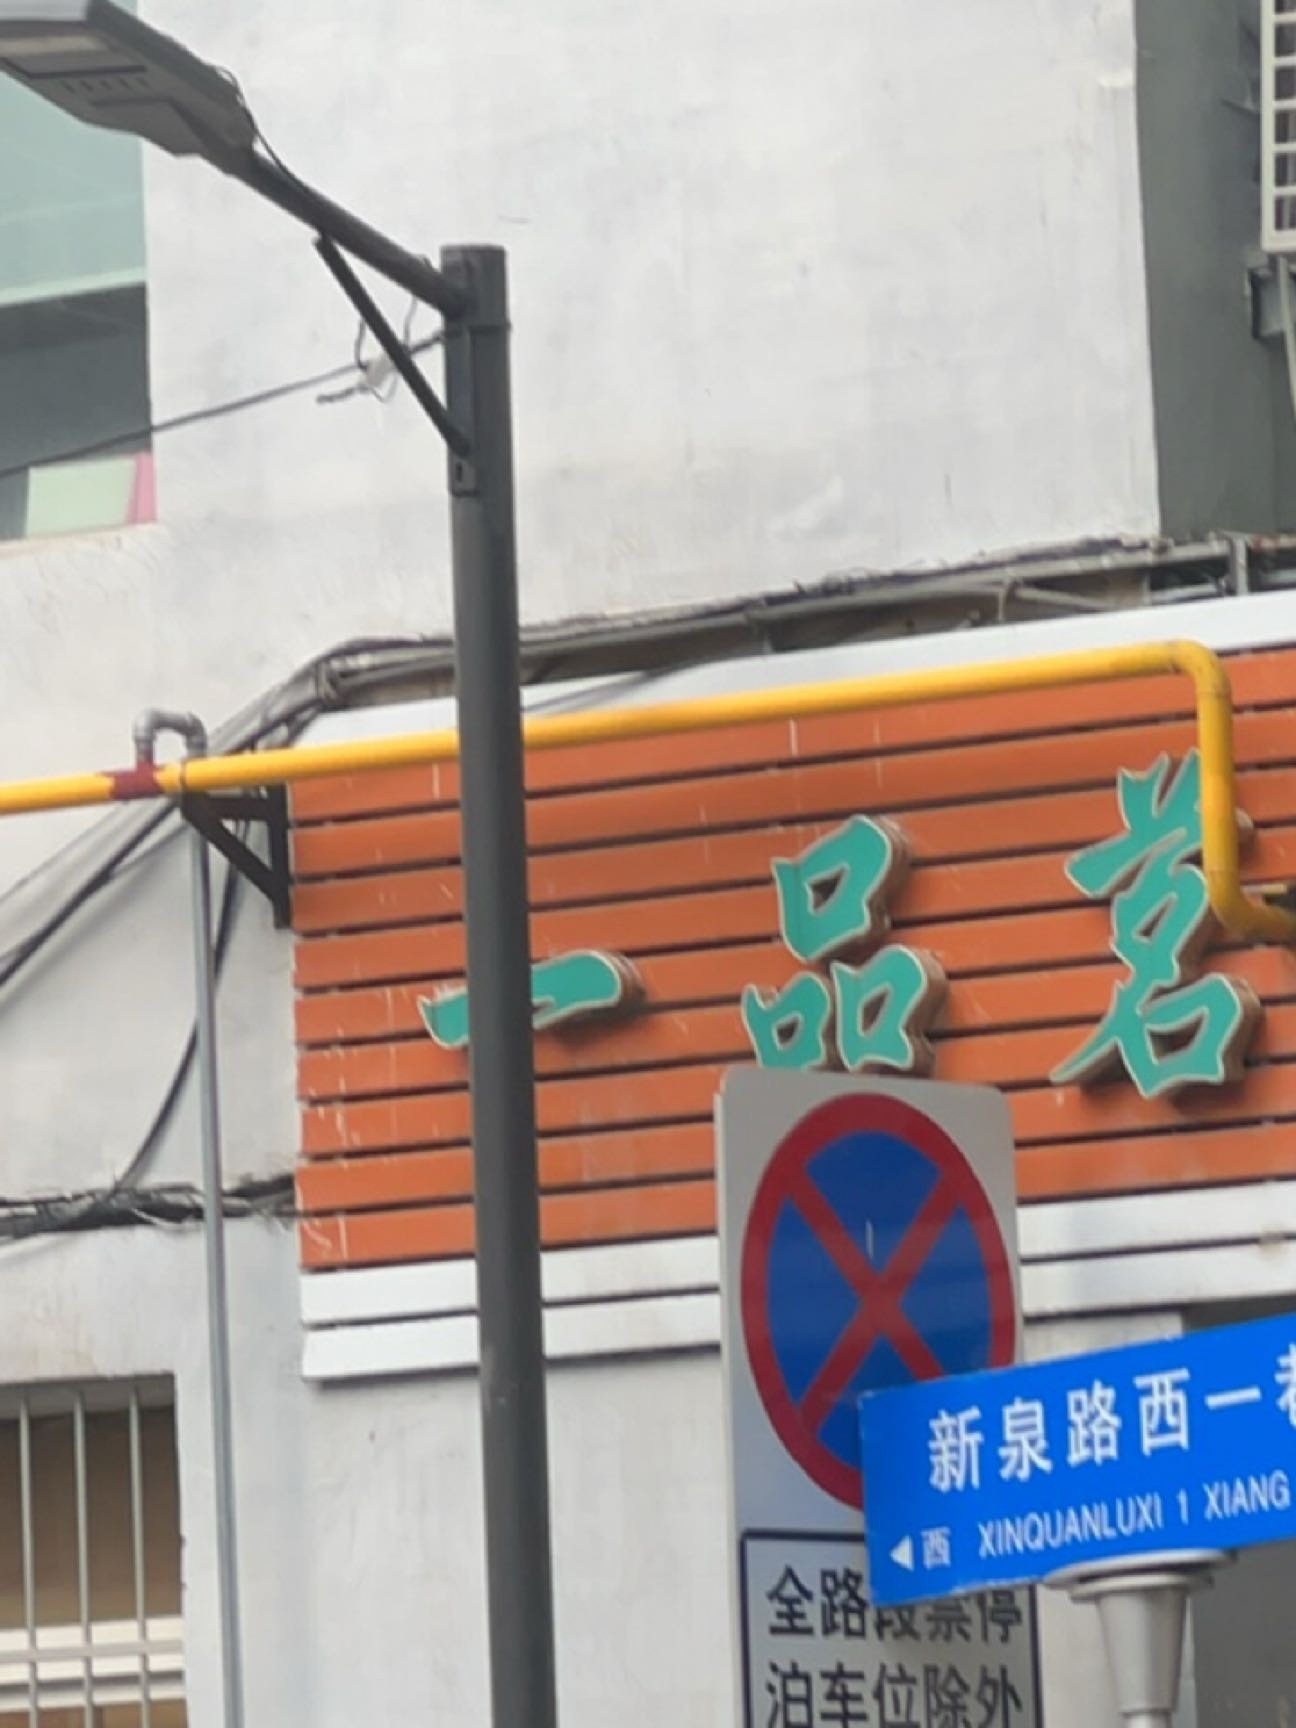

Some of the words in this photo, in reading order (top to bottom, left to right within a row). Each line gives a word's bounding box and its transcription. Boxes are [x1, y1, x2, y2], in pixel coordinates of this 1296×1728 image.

[978, 1496, 1164, 1559] XINQUANLUXI
[1203, 1472, 1291, 1519] XIANG
[921, 1527, 951, 1569] 西
